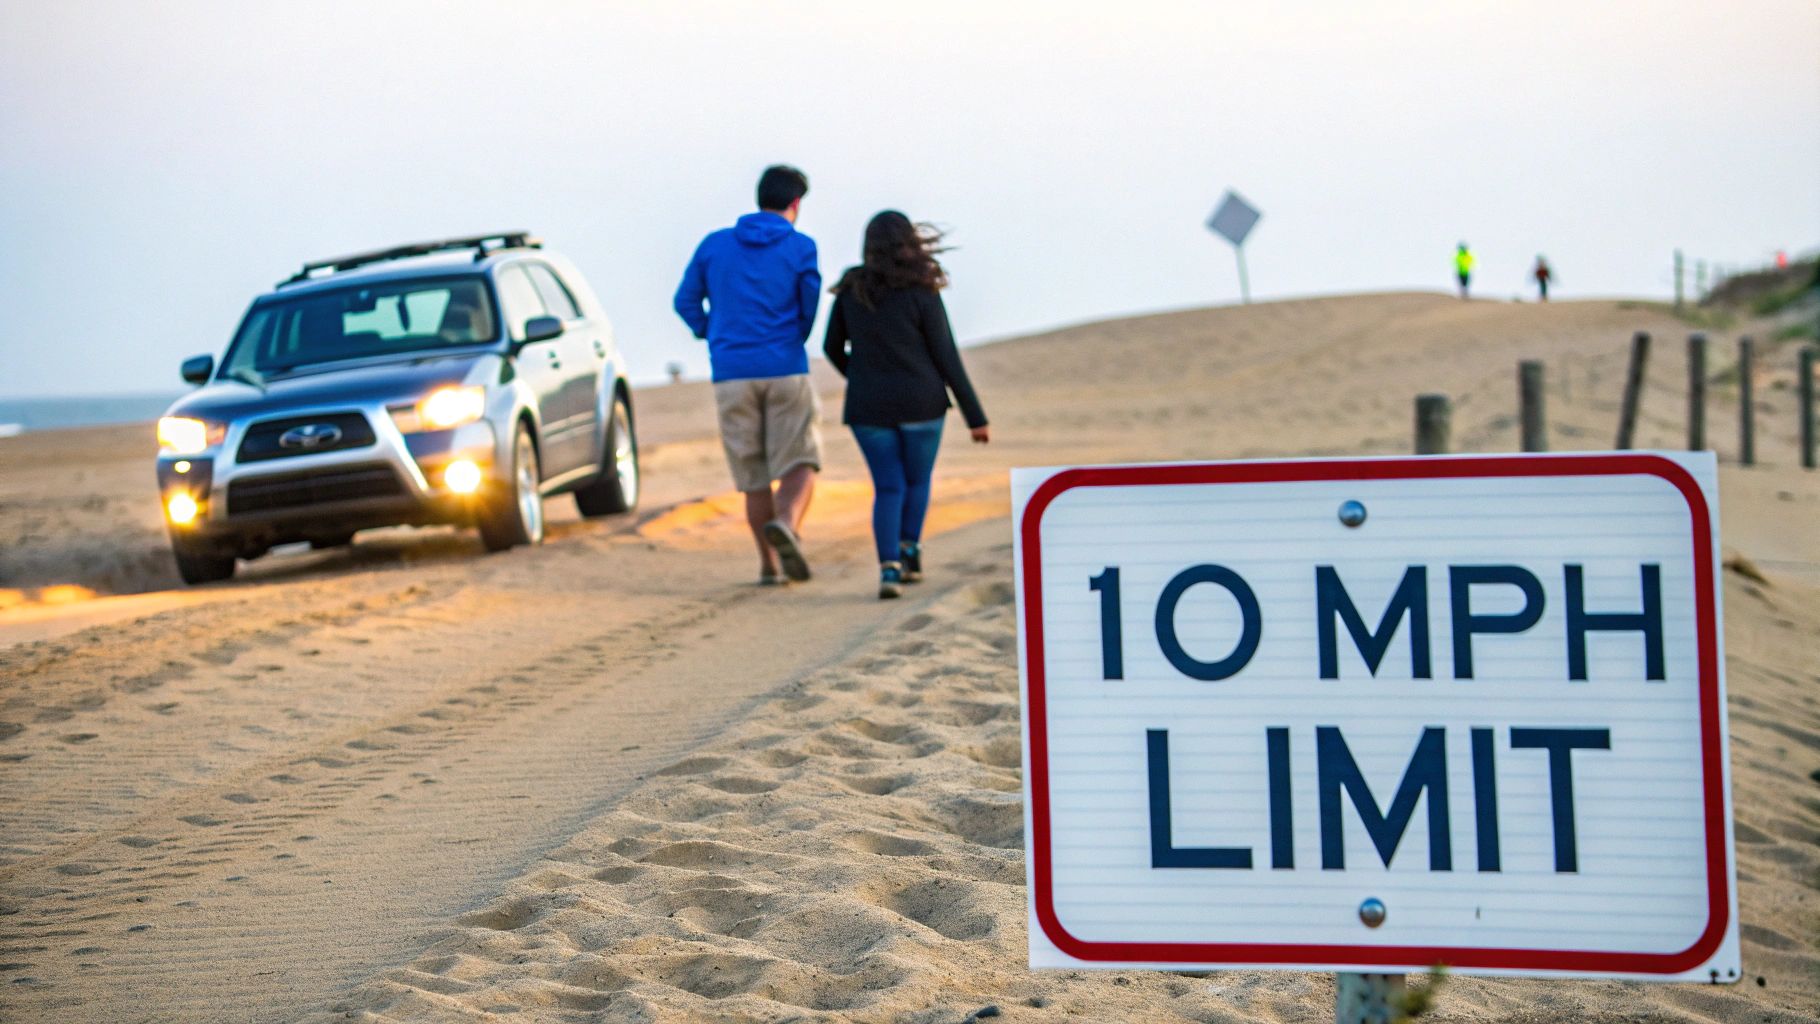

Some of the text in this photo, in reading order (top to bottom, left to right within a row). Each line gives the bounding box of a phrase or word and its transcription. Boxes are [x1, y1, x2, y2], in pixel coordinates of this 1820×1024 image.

[1089, 564, 1667, 682] 10 MPH
[1146, 727, 1611, 874] LIMIT
